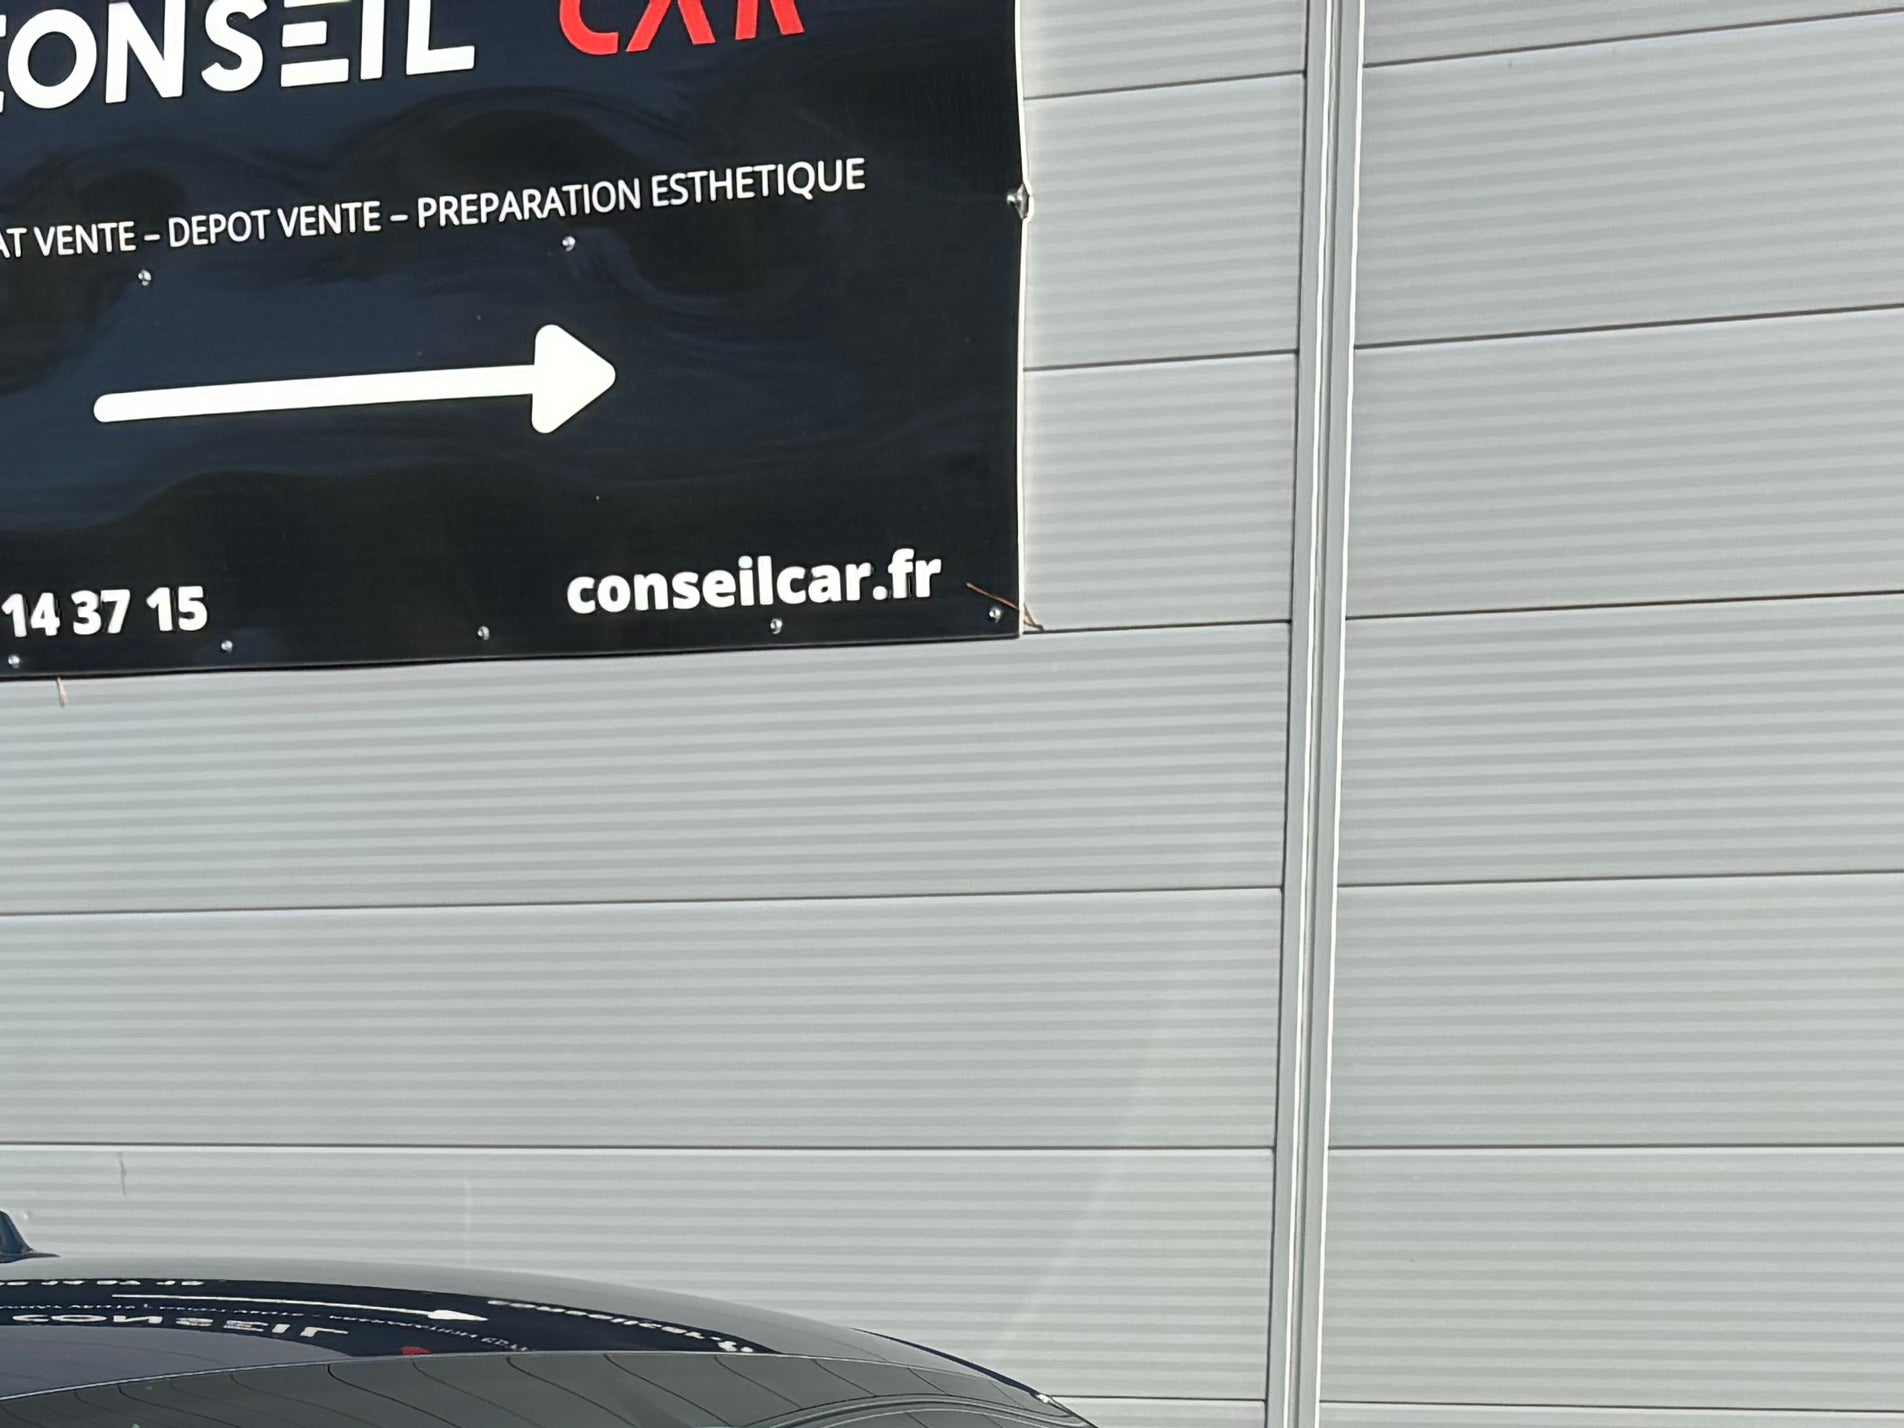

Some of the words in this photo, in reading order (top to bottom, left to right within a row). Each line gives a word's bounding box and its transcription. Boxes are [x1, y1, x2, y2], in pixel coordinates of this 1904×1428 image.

[33, 221, 137, 256] VENTE
[168, 209, 271, 248] DEPOT
[277, 201, 382, 238] VENTE
[417, 178, 642, 228] PREPARATION
[652, 157, 866, 207] ESTHETIQUE
[1, 592, 61, 638] 14
[71, 589, 131, 635] 37
[146, 585, 208, 632] 15
[566, 548, 942, 615] conseilcar.fr
